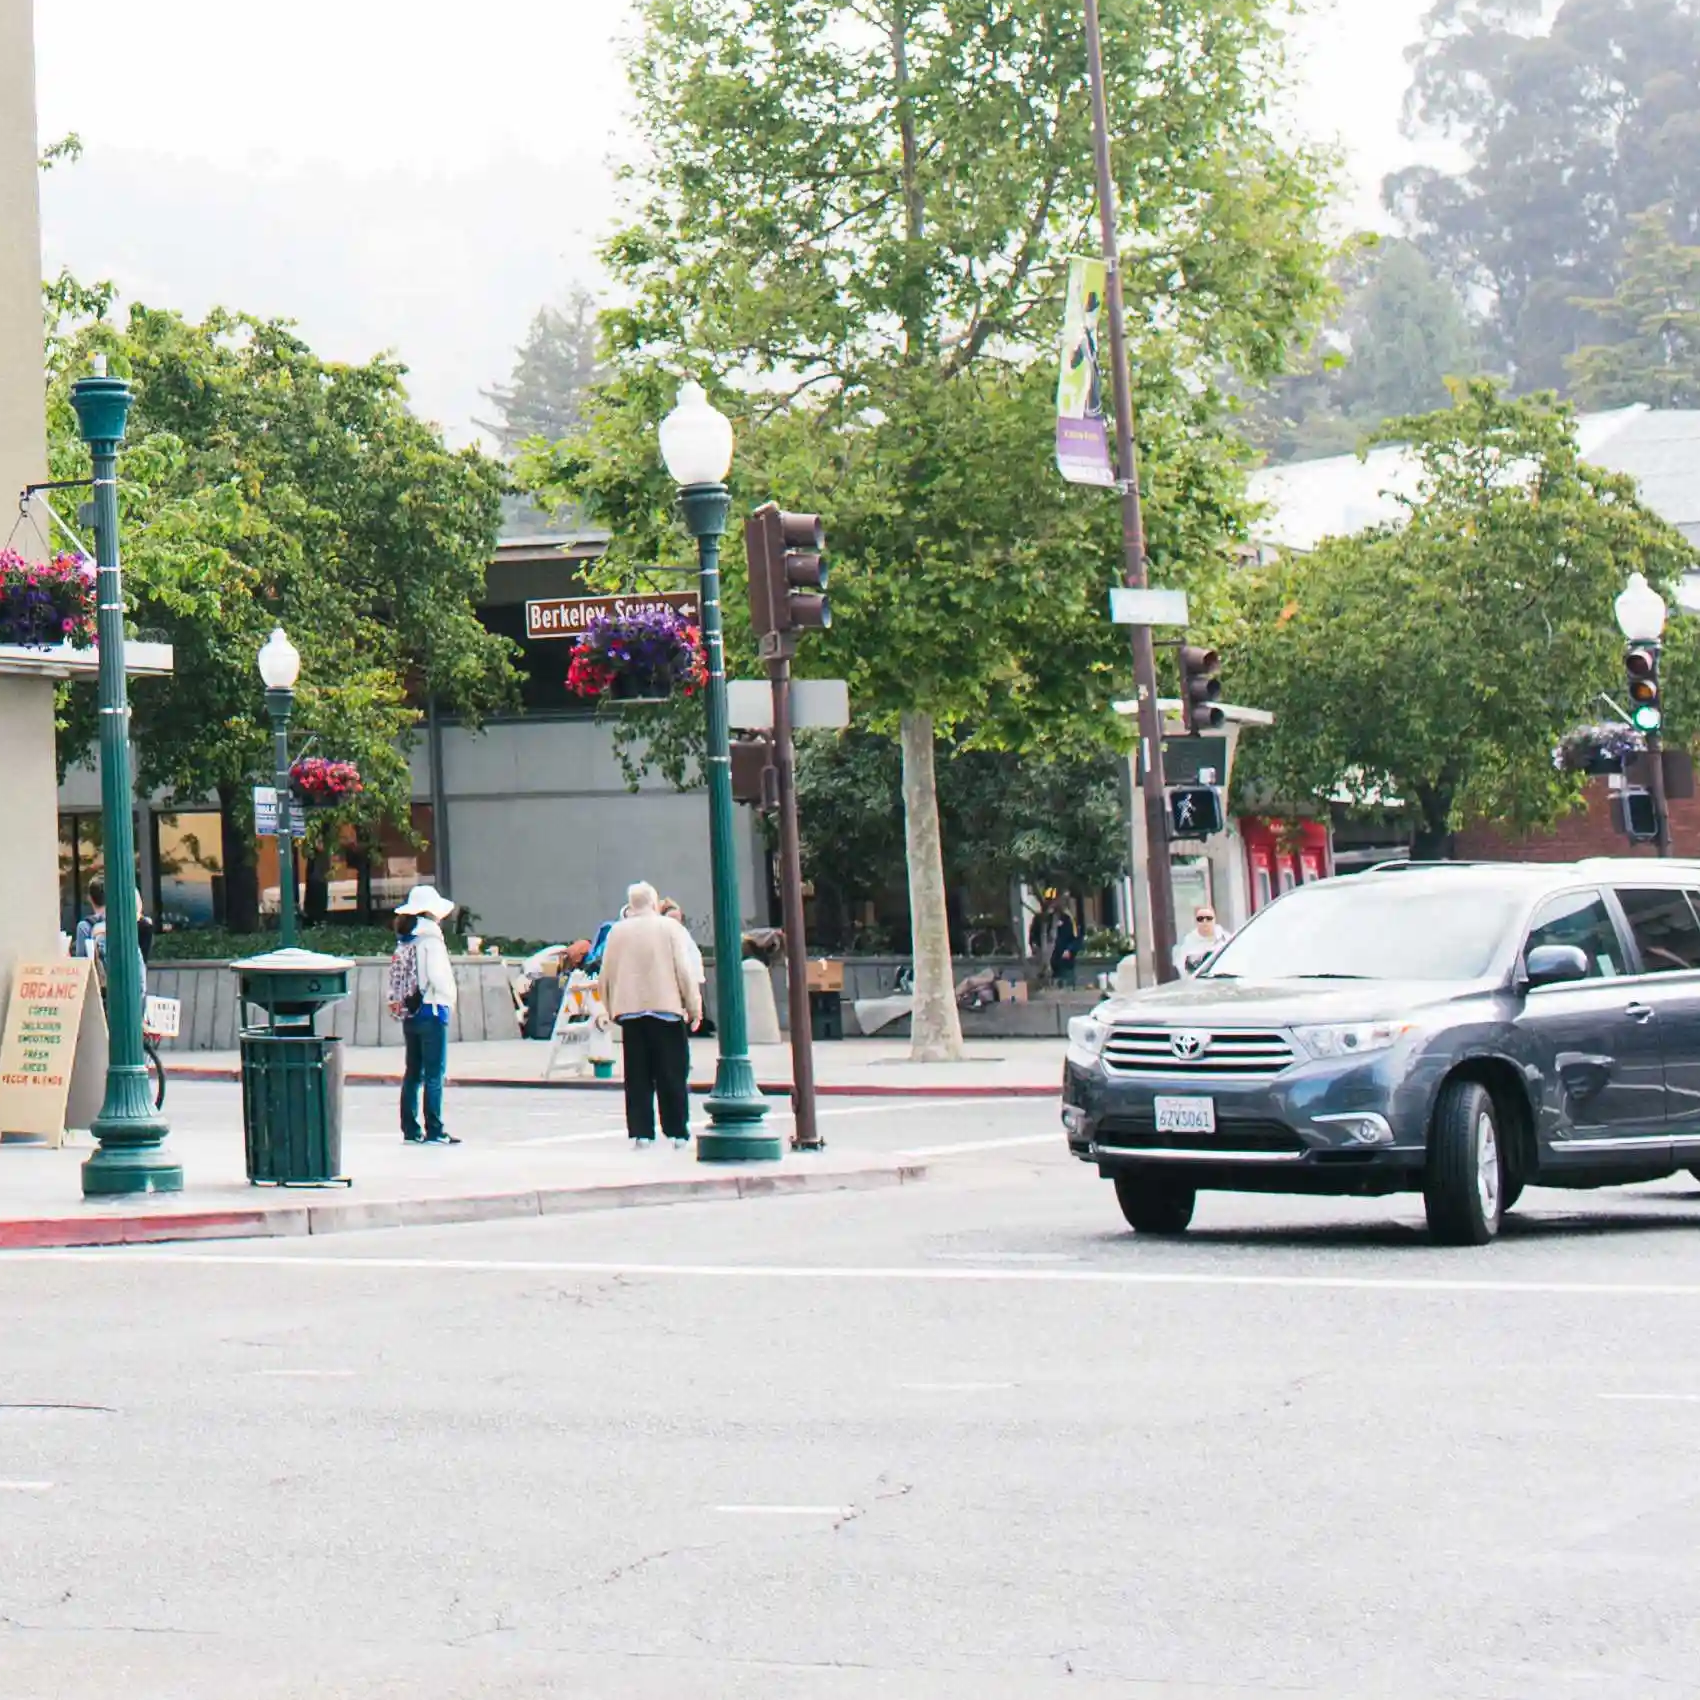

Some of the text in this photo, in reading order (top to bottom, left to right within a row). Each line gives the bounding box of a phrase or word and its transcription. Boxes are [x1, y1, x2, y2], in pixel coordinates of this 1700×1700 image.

[530, 603, 606, 629] Berkeley
[20, 982, 78, 1000] ORGANIC
[28, 1006, 58, 1016] COFFEE
[23, 1049, 49, 1059] FRESH
[32, 1075, 63, 1086] BLENDS
